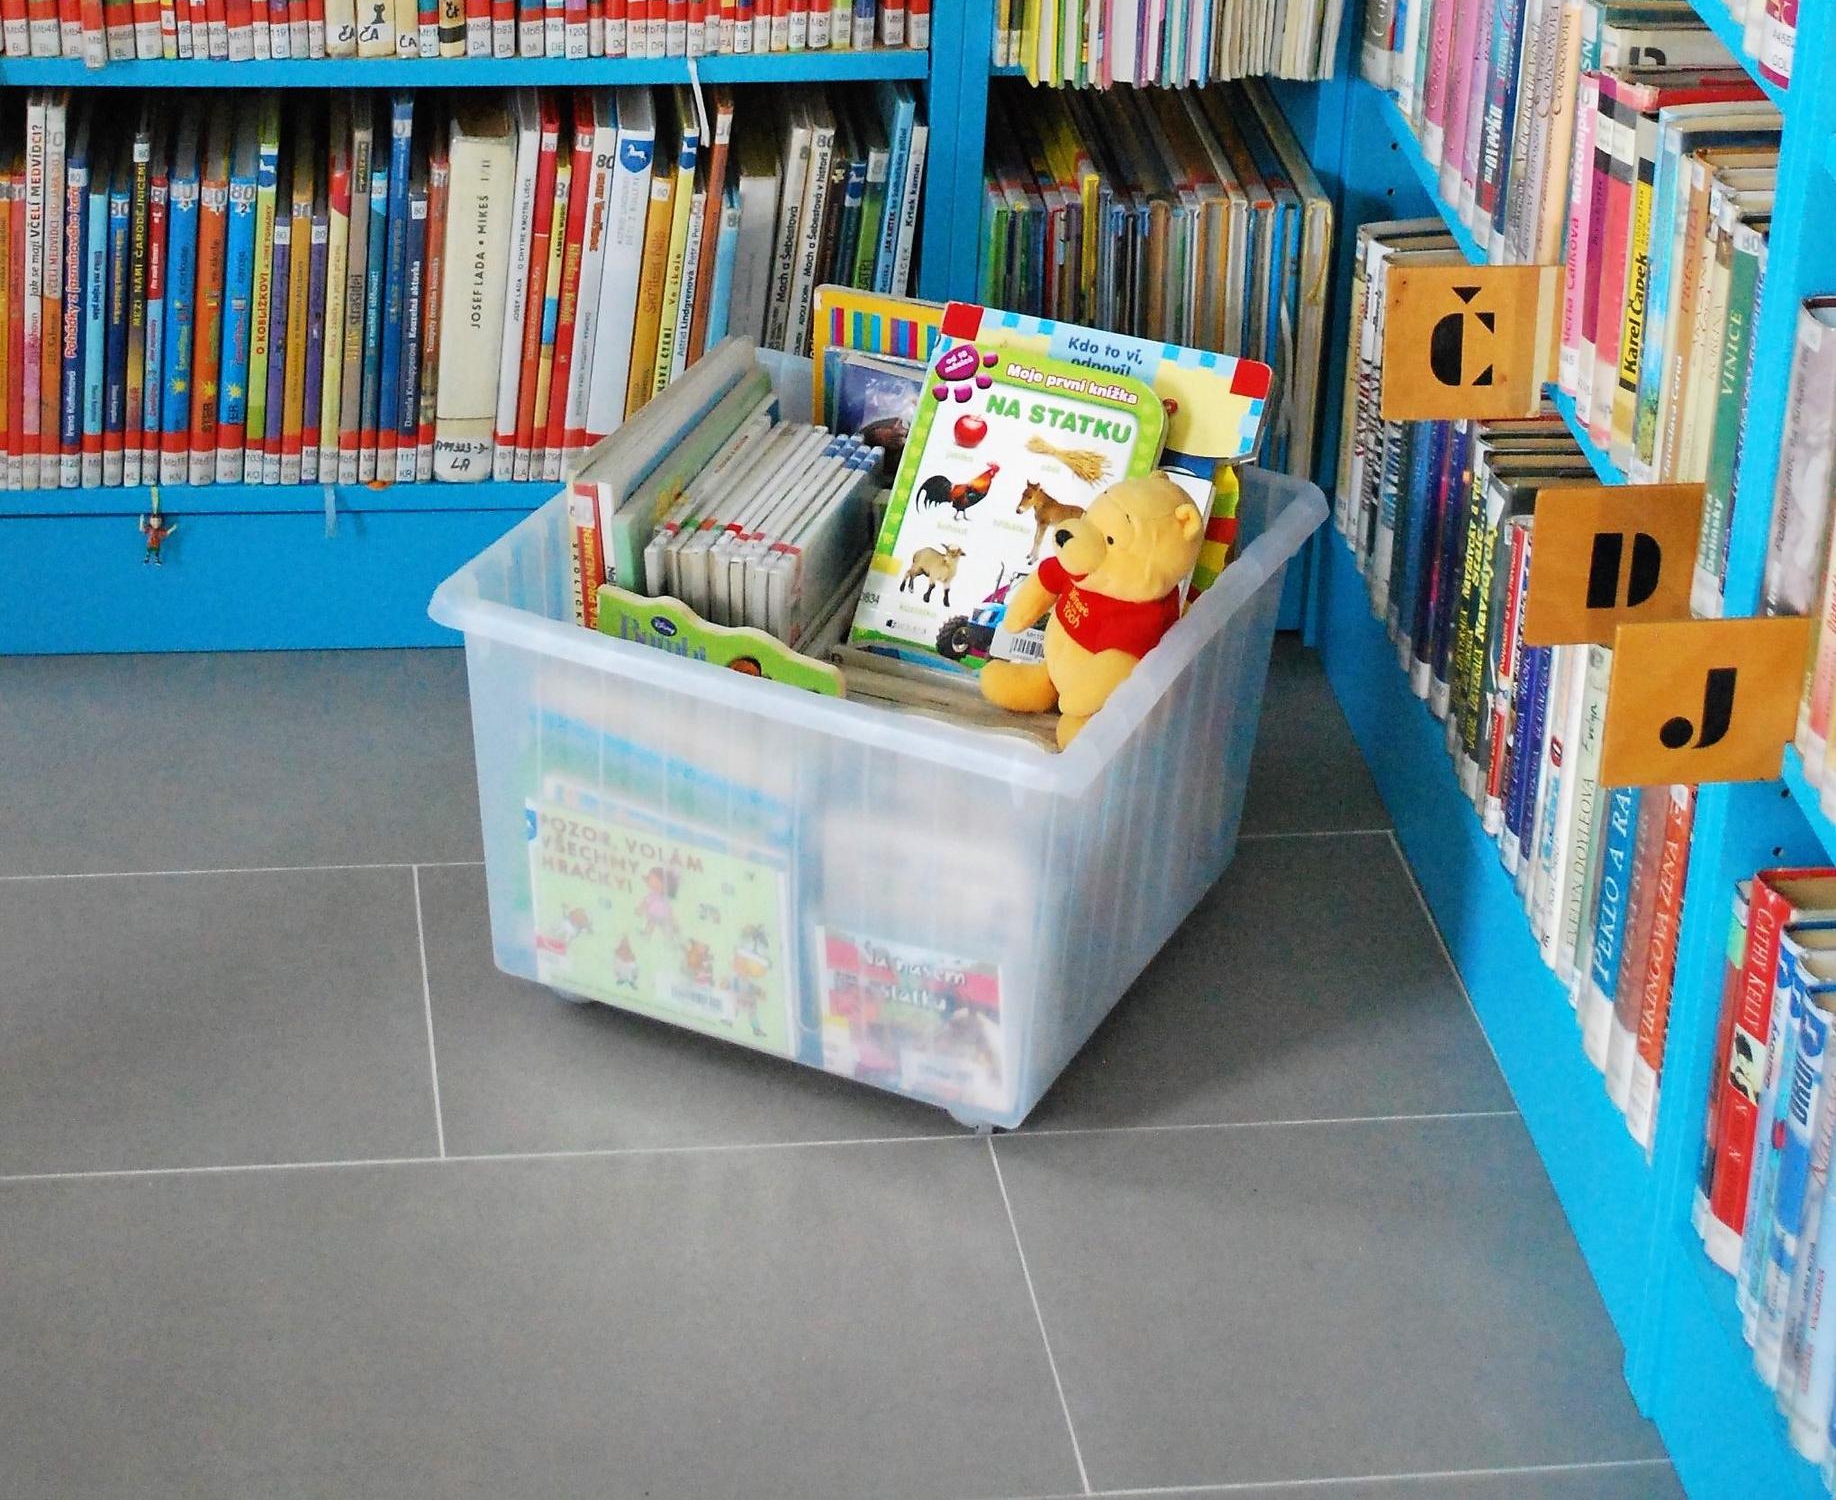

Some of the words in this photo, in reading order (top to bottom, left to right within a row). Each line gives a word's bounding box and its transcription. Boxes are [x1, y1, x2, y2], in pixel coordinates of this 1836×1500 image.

[779, 206, 799, 261] Šebestová
[472, 251, 485, 286] LADA
[775, 274, 788, 303] Mach
[802, 252, 815, 277] Mach
[1618, 252, 1649, 316] Čapek
[470, 289, 482, 329] JOSEF
[681, 269, 697, 330] Lindgrenová
[1067, 336, 1100, 355] Kdo
[1104, 344, 1120, 359] to
[1620, 320, 1642, 376] Karel
[1719, 309, 1742, 396] VINICE
[1006, 363, 1043, 383] Moje
[1045, 370, 1086, 392] první
[985, 393, 1023, 420] NA
[1029, 404, 1134, 444] STATKU
[1585, 531, 1662, 609] D
